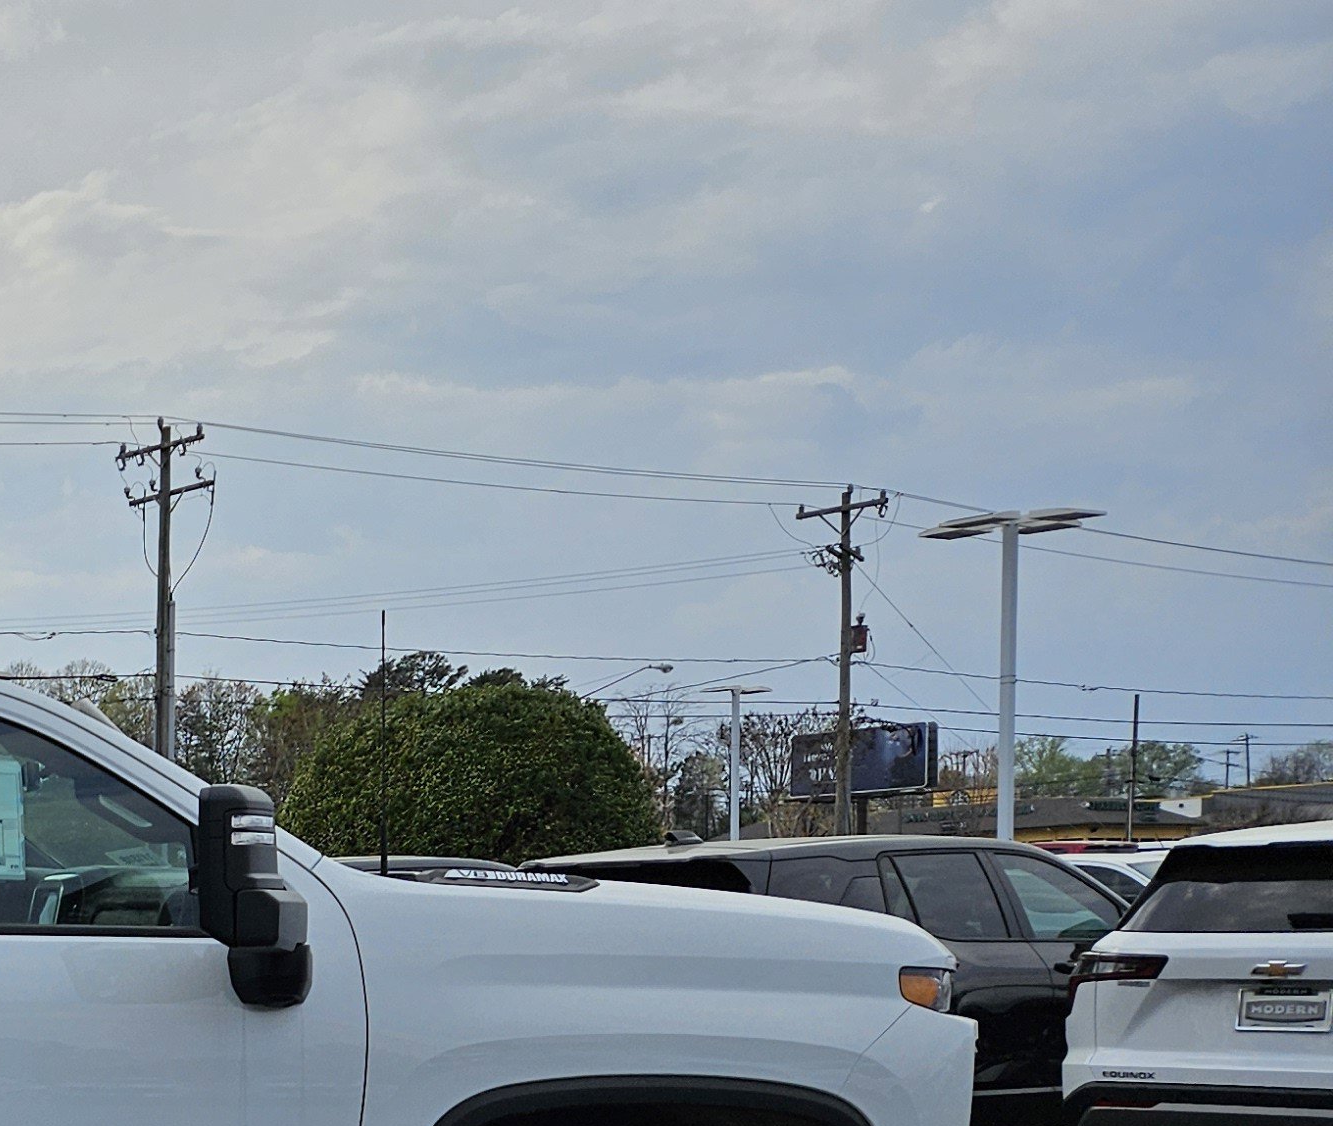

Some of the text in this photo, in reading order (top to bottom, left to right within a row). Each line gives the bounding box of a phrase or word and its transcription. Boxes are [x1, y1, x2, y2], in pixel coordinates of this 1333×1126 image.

[494, 871, 569, 884] DURAMAX
[1251, 1004, 1319, 1015] MODERN
[1102, 1071, 1156, 1079] EQUINOX
